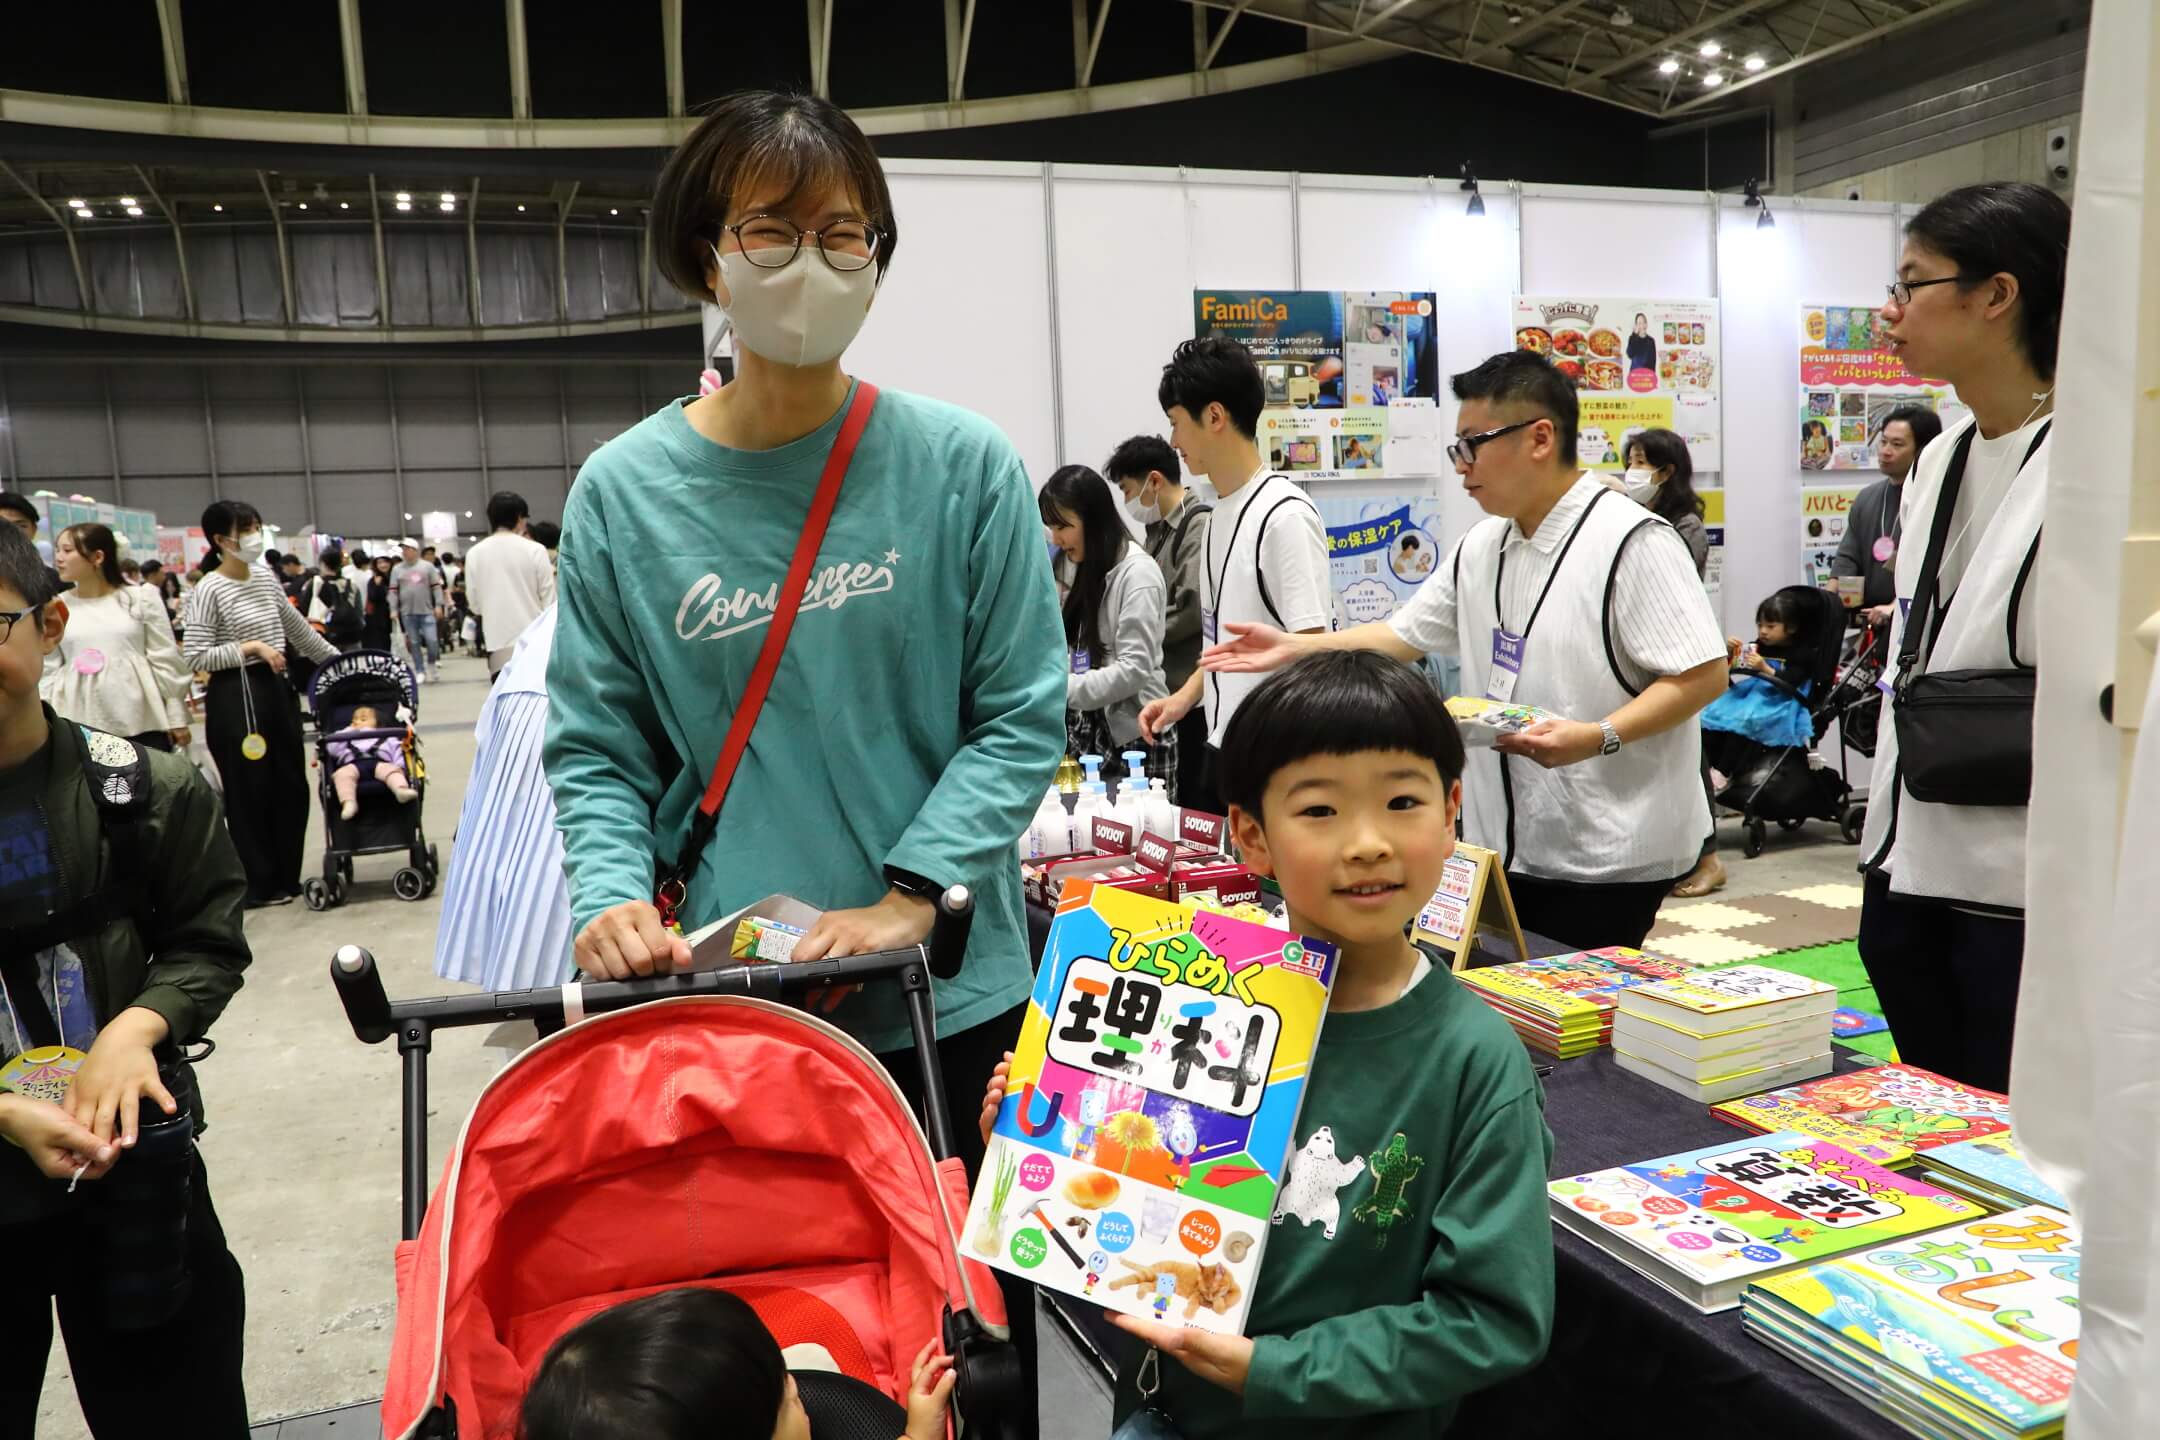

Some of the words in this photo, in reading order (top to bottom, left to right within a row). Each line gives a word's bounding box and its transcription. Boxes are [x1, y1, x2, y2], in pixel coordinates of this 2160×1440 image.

[1200, 296, 1288, 321] FamiCa
[1096, 824, 1125, 844] SOYJOY
[1184, 816, 1216, 835] SOYJOY
[1141, 840, 1169, 862] SOYJOY
[1221, 890, 1258, 904] SOYJOY
[1281, 941, 1327, 969] GET!
[1108, 926, 1264, 1007] ひらめく
[1059, 976, 1266, 1108] 理科
[1022, 1164, 1051, 1175] そだてて
[1025, 1173, 1047, 1184] みよう
[1779, 1147, 1910, 1204] あそべる
[1715, 1152, 1882, 1224] 算数
[1103, 1222, 1129, 1233] どうして
[1190, 1217, 1216, 1235] じっくり
[1015, 1233, 1046, 1256] どうやって
[1099, 1232, 1131, 1246] ふくらむ?
[1180, 1227, 1215, 1249] 見てみよう
[1015, 1248, 1035, 1262] 使う?
